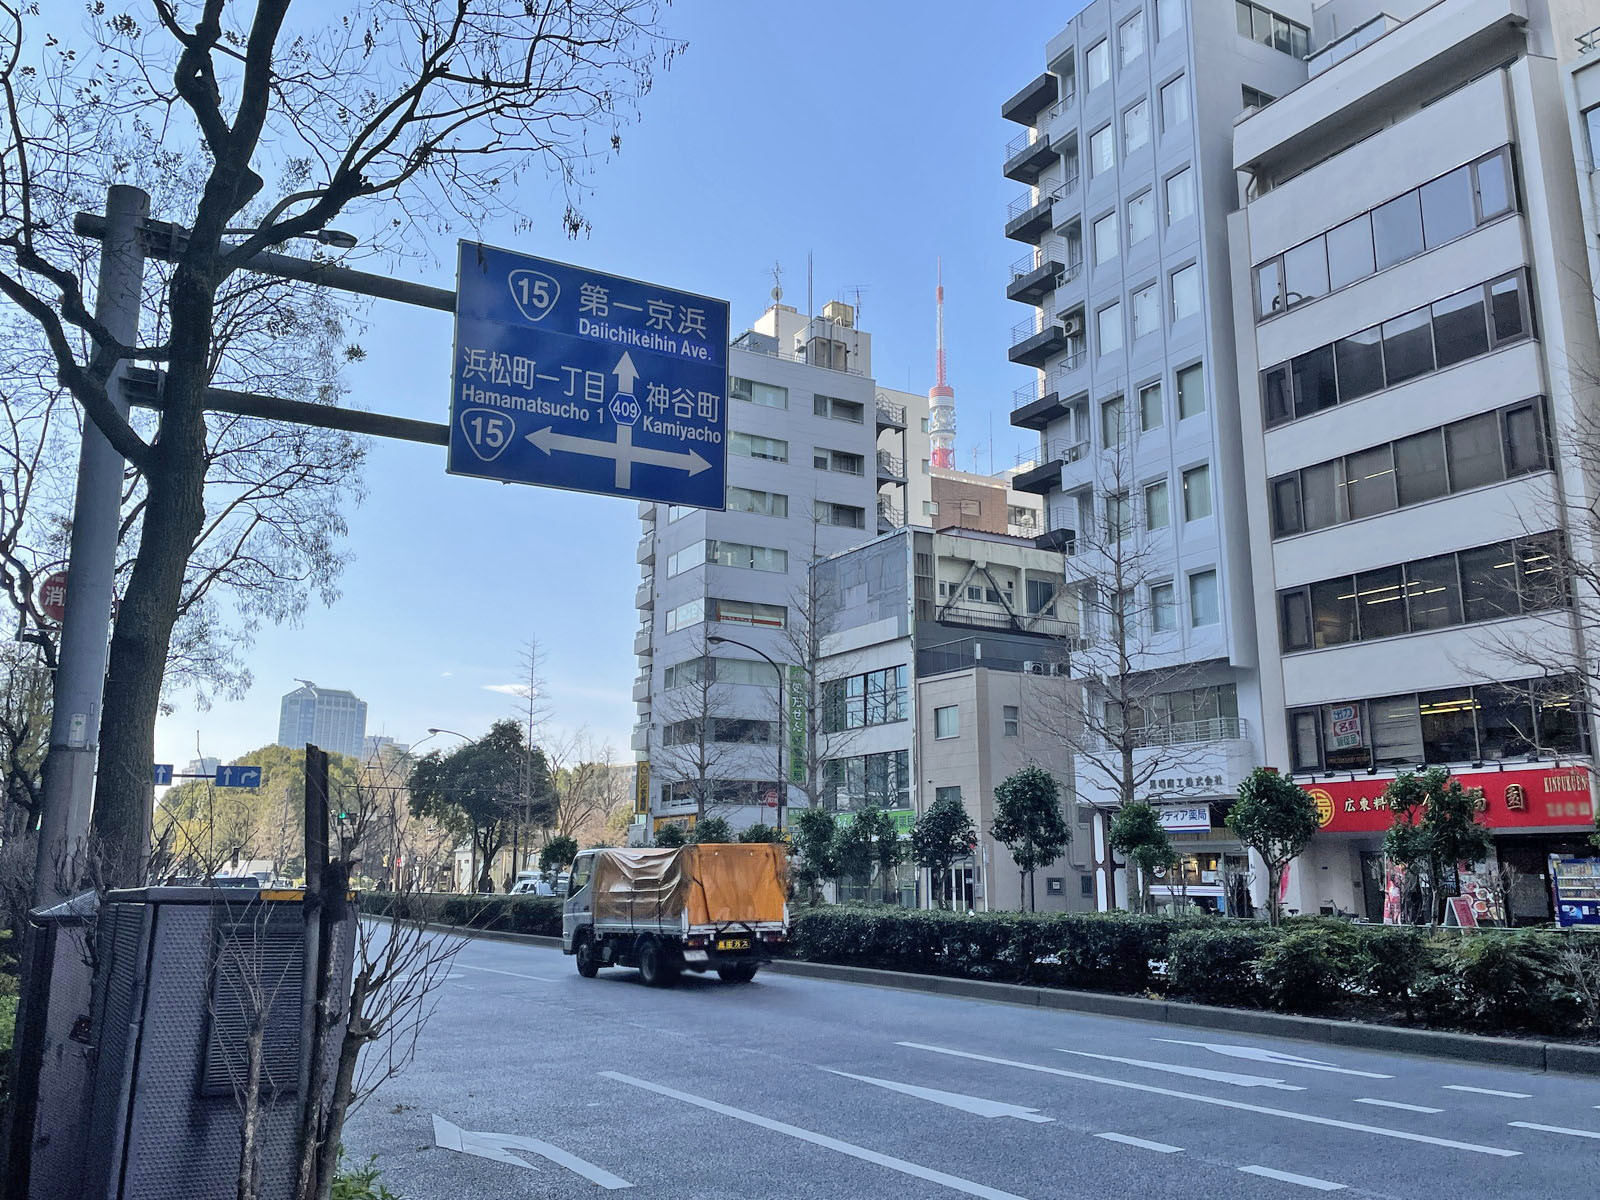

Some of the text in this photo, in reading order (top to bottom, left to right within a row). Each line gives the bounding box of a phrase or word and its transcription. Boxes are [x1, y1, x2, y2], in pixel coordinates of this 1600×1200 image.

[518, 278, 550, 309] 15
[578, 281, 707, 340] 第一京浜
[578, 317, 712, 361] Daiichikeihin Ave.
[461, 345, 605, 403] 浜松町一丁目
[461, 383, 605, 424] Hamamatsucho 1
[612, 399, 638, 419] 409
[645, 382, 721, 424] 神谷町
[470, 416, 504, 448] 15
[643, 415, 722, 445] Kamiyacho
[1333, 708, 1353, 720] 出力
